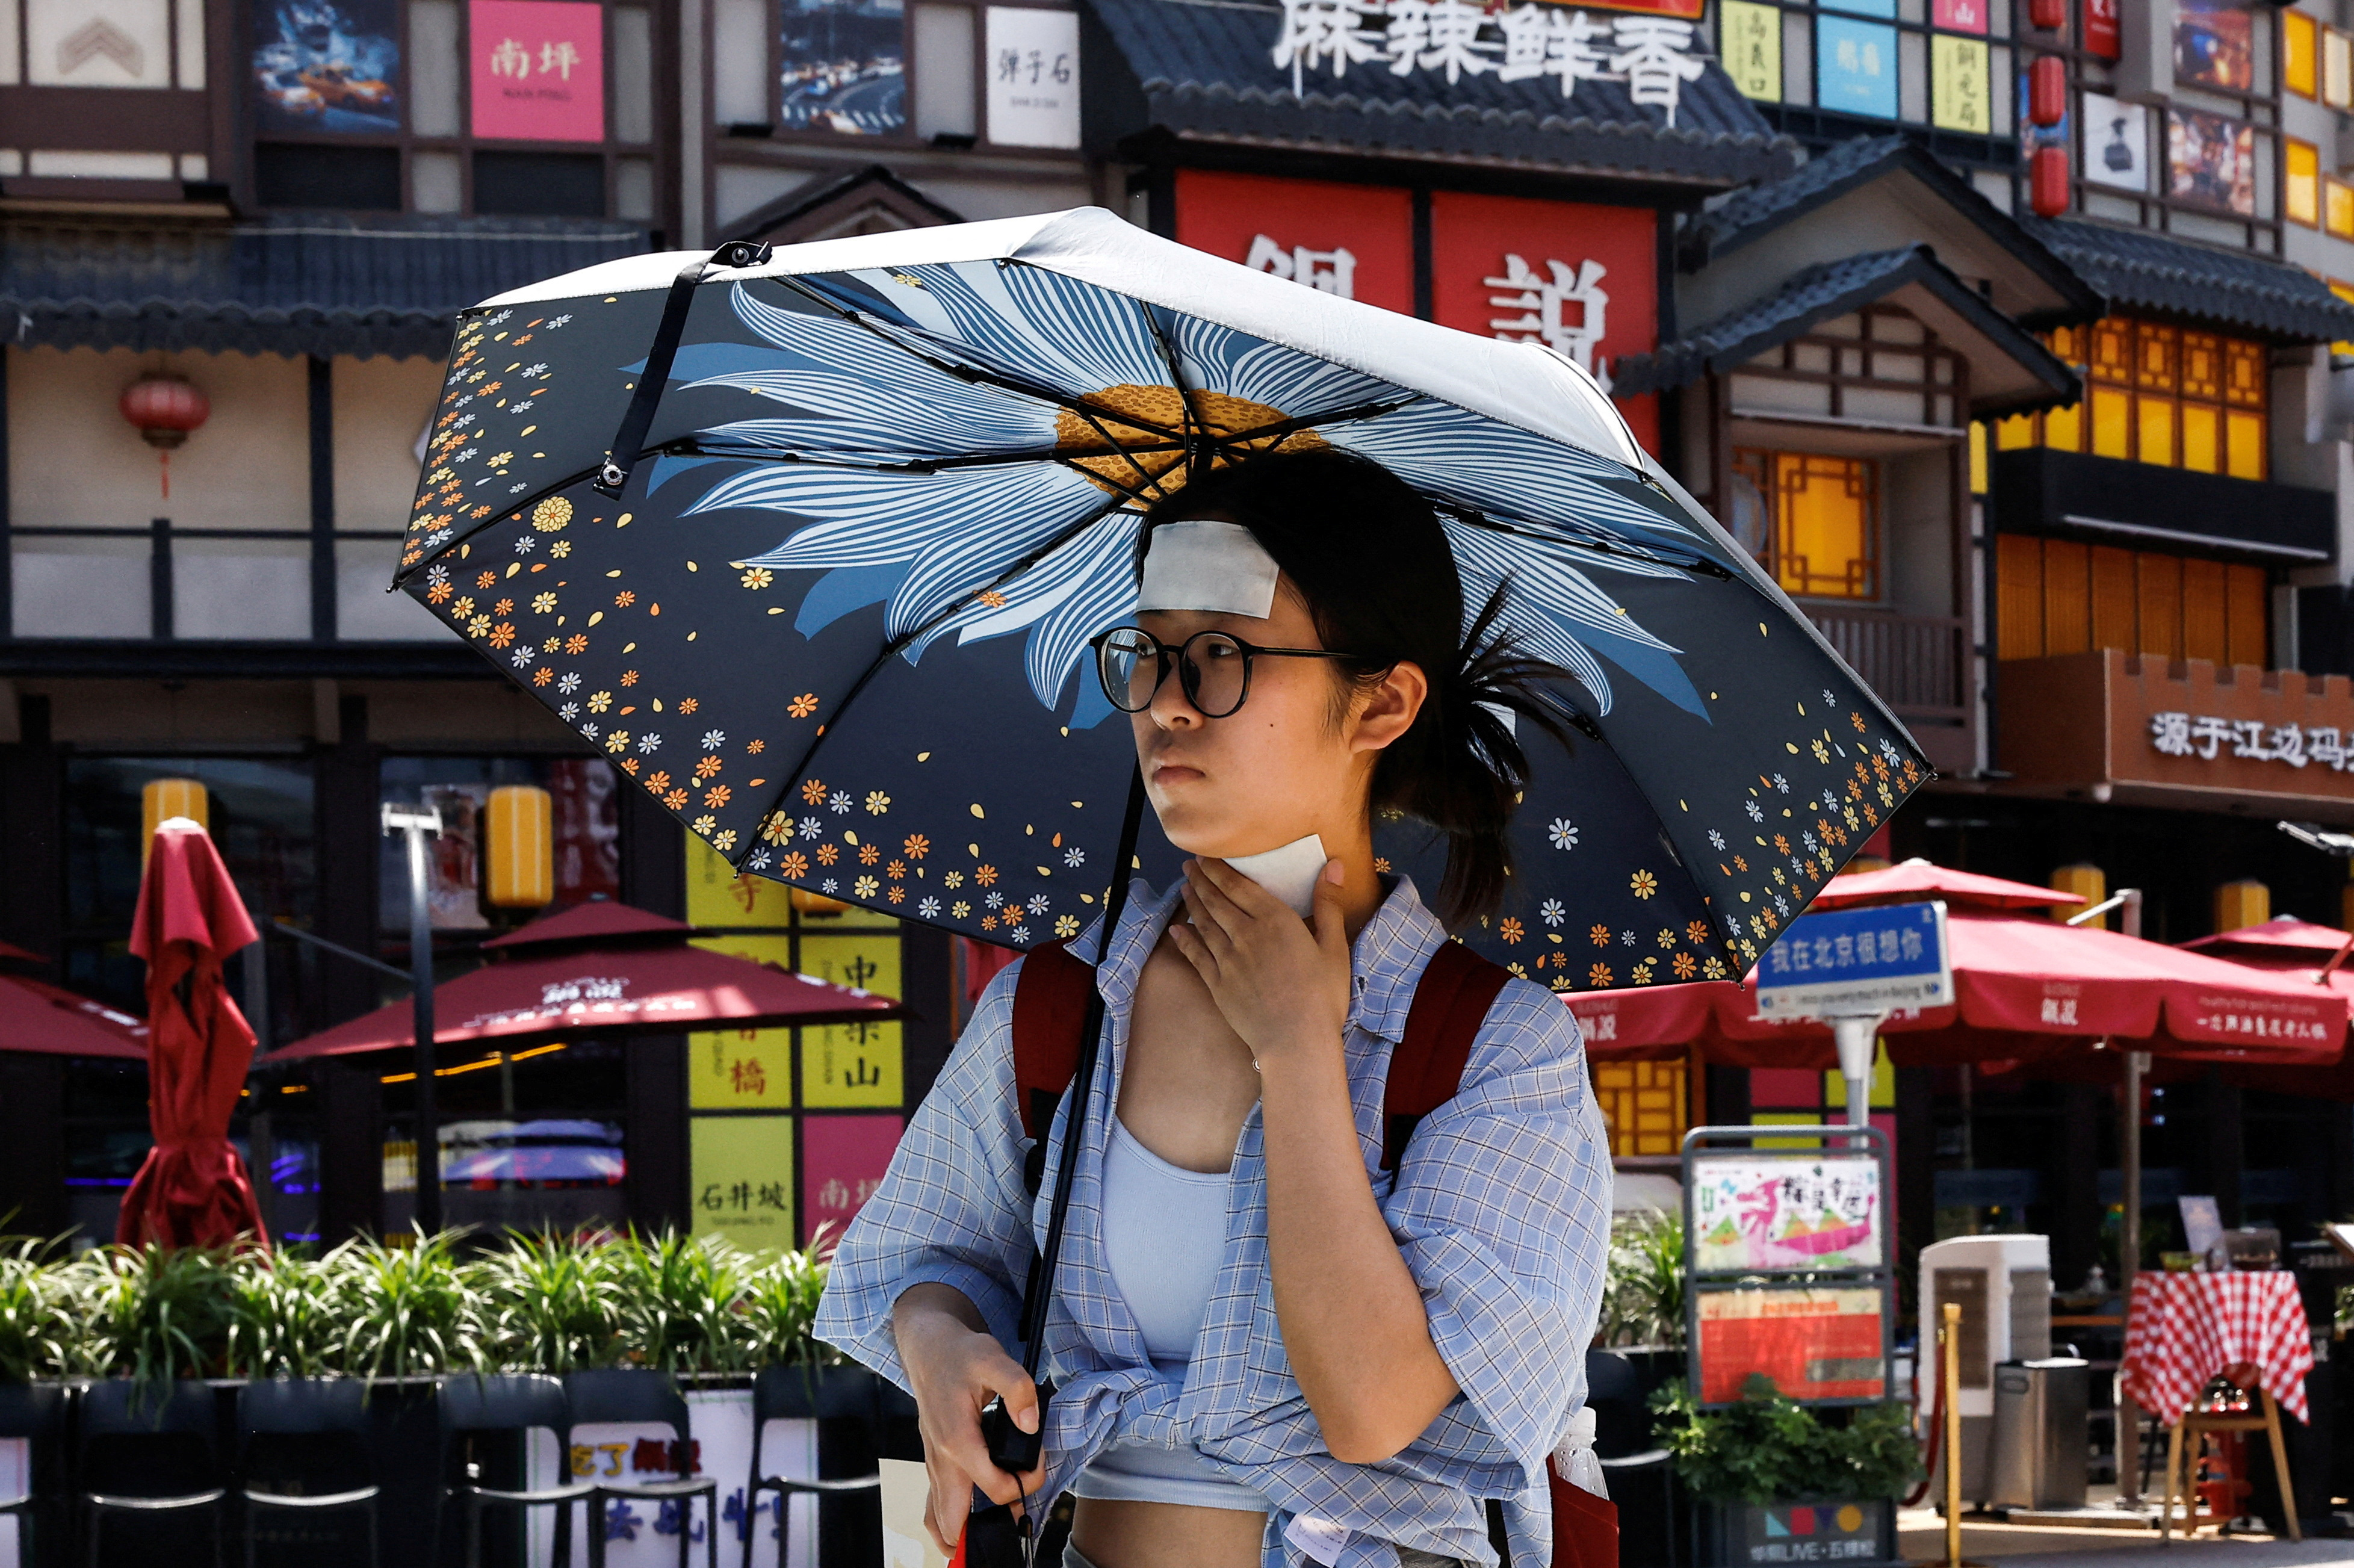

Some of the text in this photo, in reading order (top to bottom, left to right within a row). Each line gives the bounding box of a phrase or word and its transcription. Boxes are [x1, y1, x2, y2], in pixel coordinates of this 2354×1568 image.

[491, 37, 580, 81] 南坪
[1272, 0, 1705, 106] 麻辣鲜香
[1772, 928, 1922, 973] 我在北京很想你
[698, 1181, 787, 1211] 石井坡
